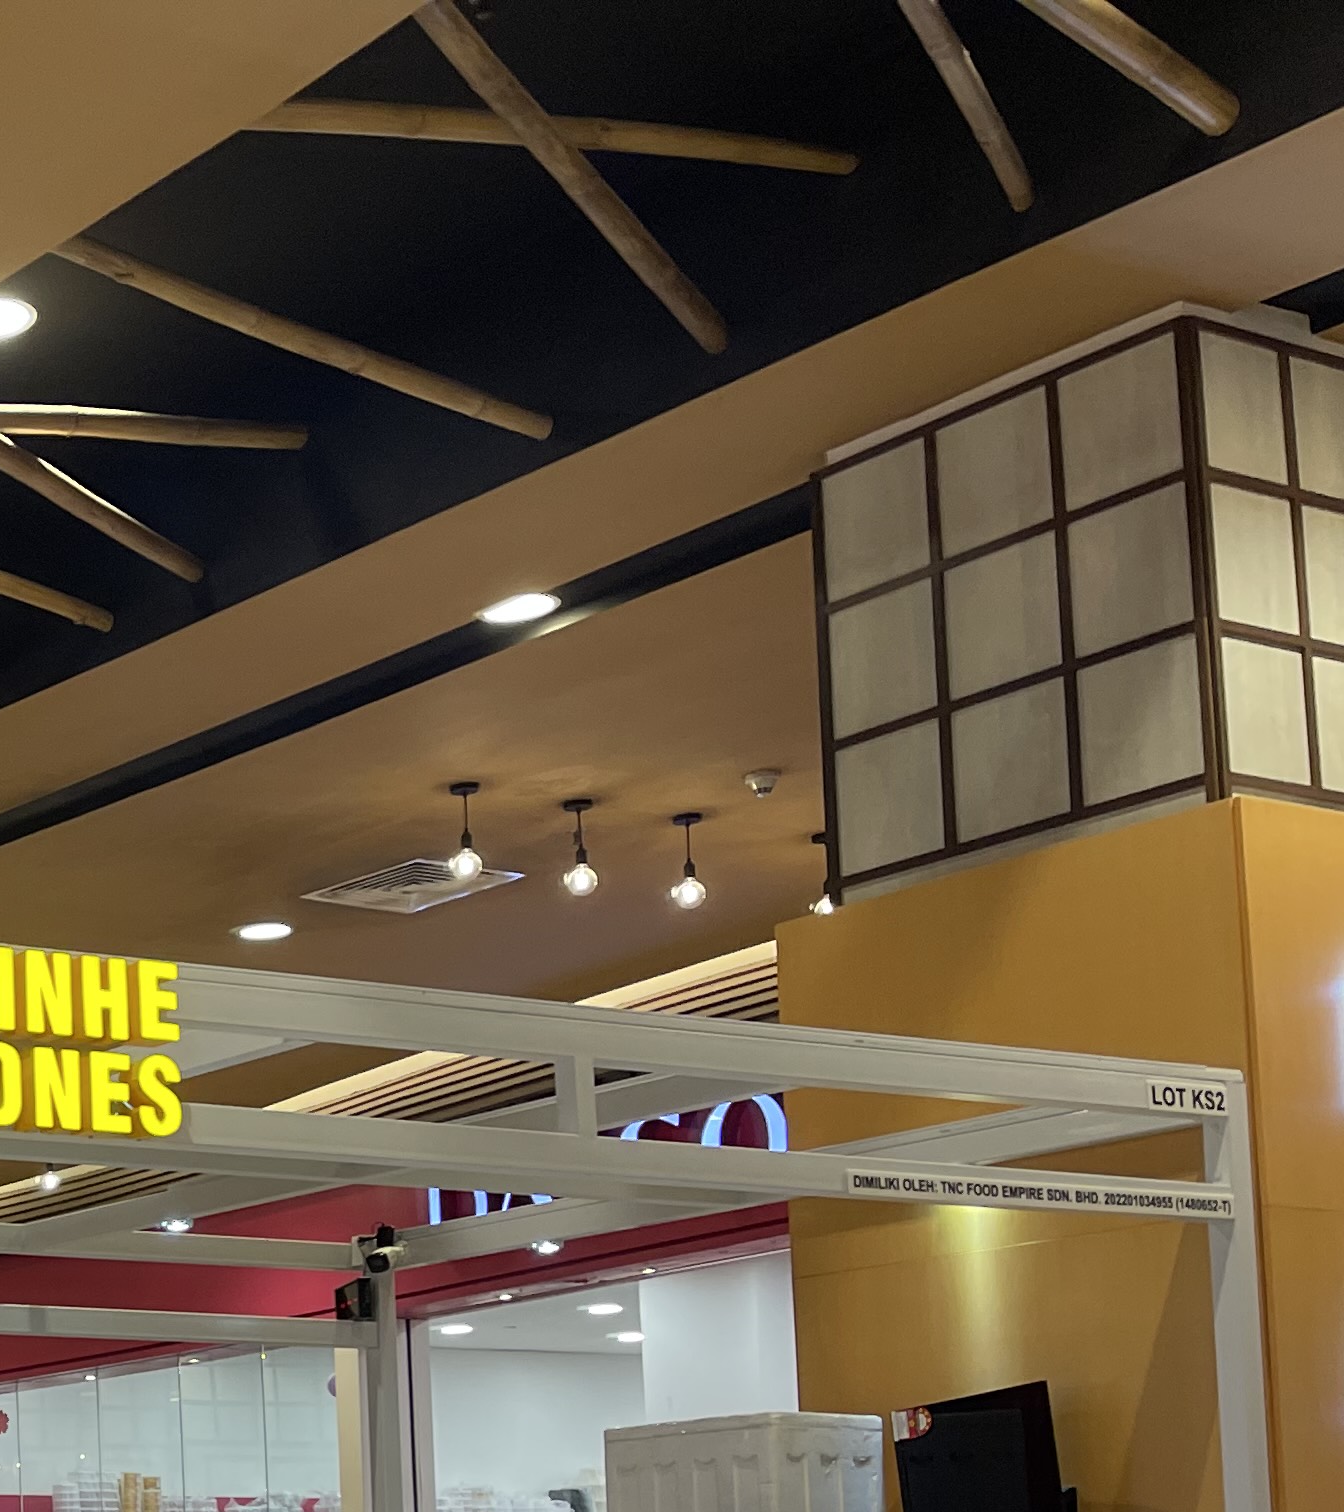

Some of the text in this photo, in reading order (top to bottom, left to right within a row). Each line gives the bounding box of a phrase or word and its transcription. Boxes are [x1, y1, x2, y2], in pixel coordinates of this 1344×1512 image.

[1151, 1085, 1226, 1112] LOT KS2
[852, 1174, 901, 1191] DIMILIKI
[902, 1178, 939, 1194] OLEH:
[940, 1180, 965, 1196] TNC
[966, 1182, 999, 1198] FOOD
[1001, 1185, 1044, 1201] EMPIRE
[1046, 1188, 1072, 1203] SDN.
[1074, 1190, 1101, 1205] BHD.
